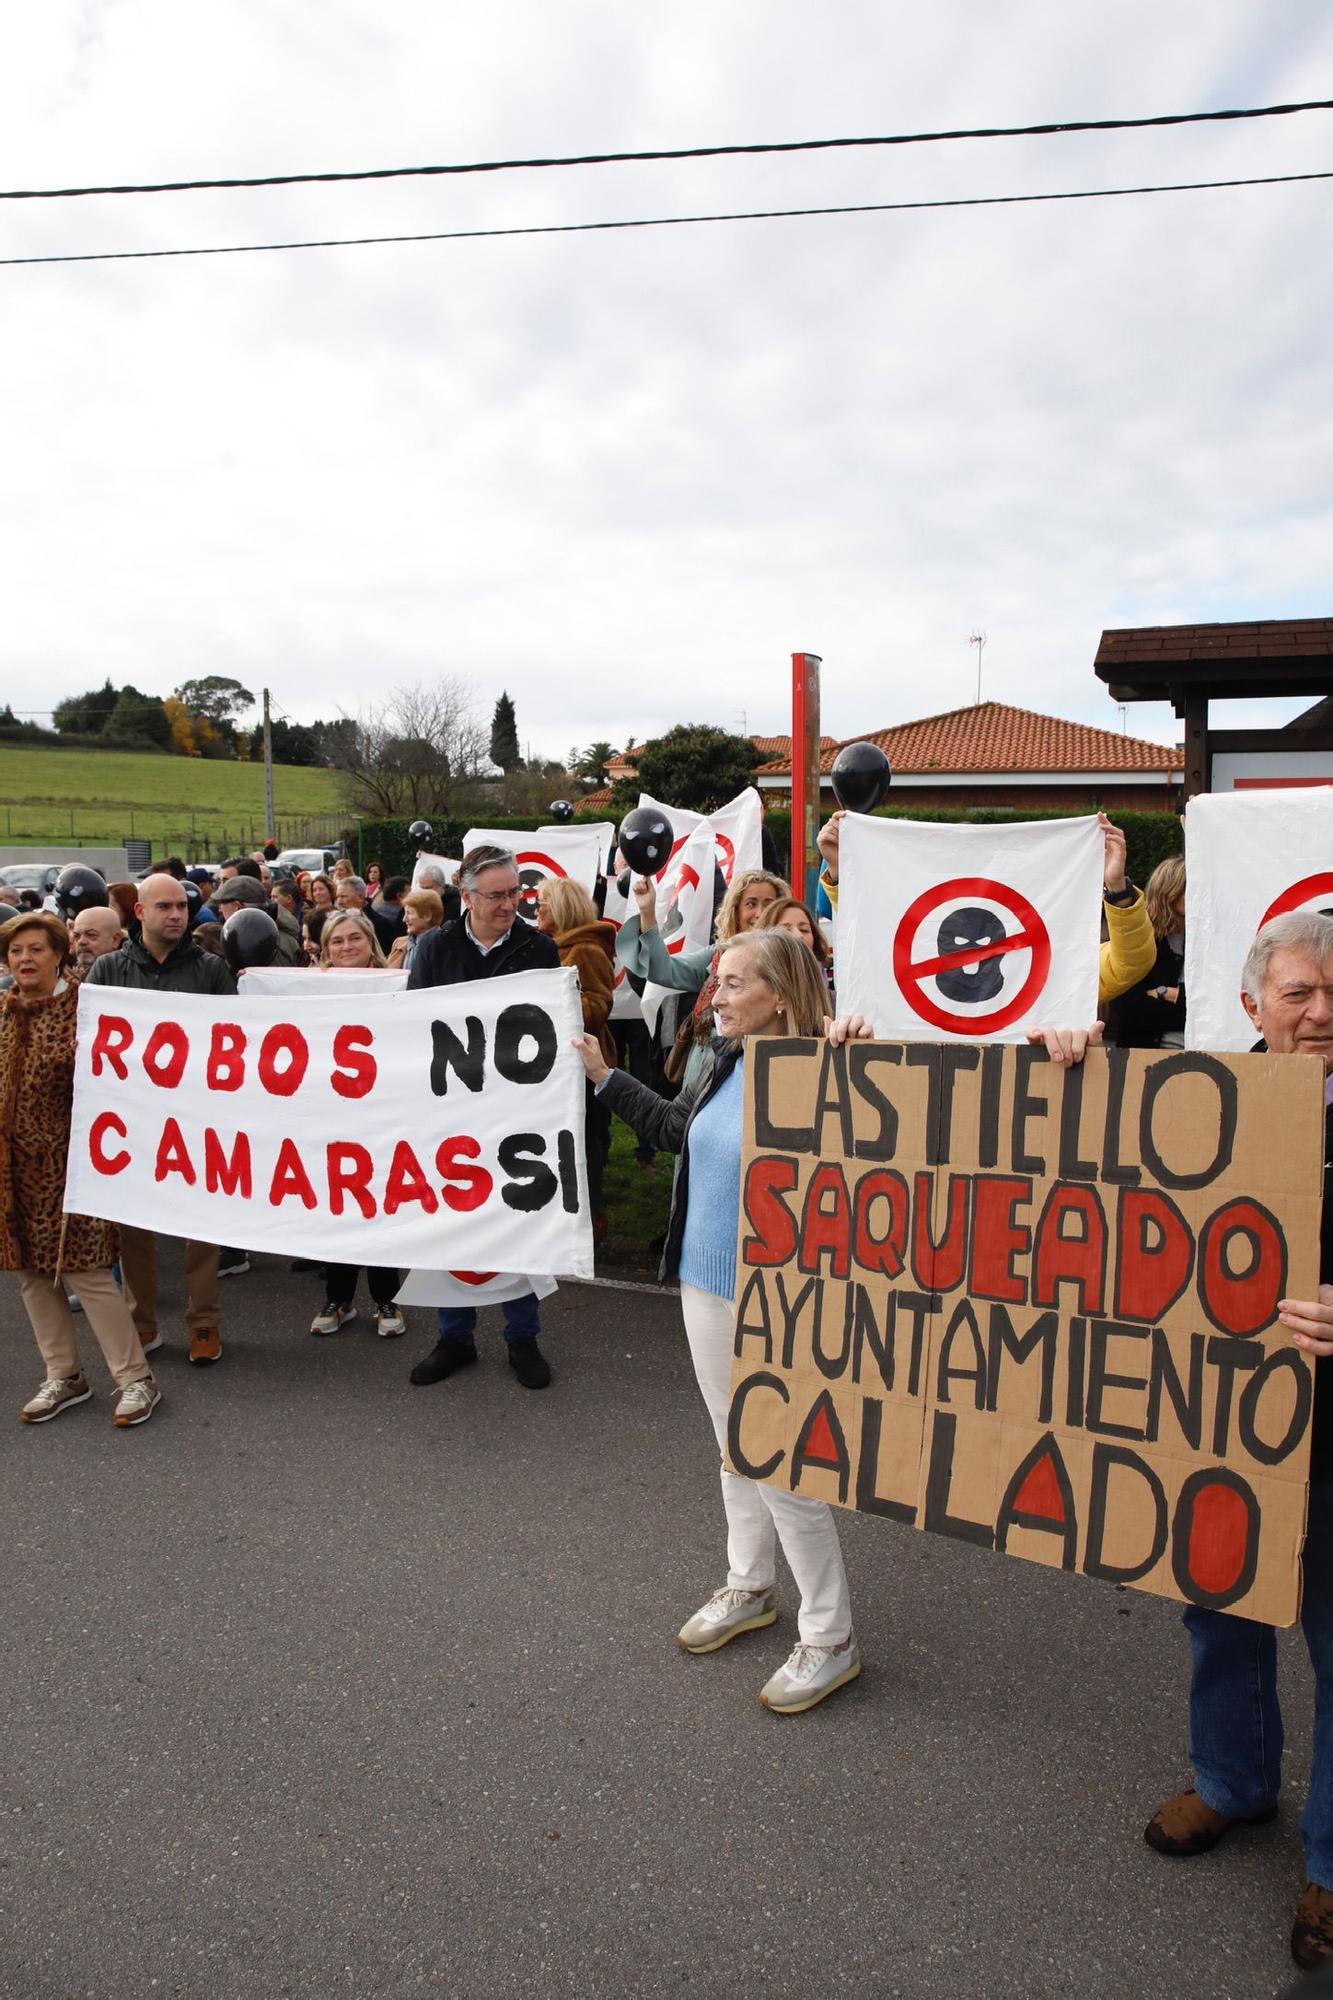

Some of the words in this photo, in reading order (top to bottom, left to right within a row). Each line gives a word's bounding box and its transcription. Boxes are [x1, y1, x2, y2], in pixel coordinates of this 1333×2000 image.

[90, 1014, 377, 1098] ROBOS
[430, 1003, 557, 1096] NO
[754, 1038, 1238, 1190] CASTIELLO
[88, 1111, 493, 1219] CAMARAS
[498, 1129, 578, 1213] SI
[743, 1155, 1287, 1337] SAQUEADO
[734, 1269, 1312, 1465] AYUNTAMIENTO
[728, 1372, 1260, 1609] CALLADO
